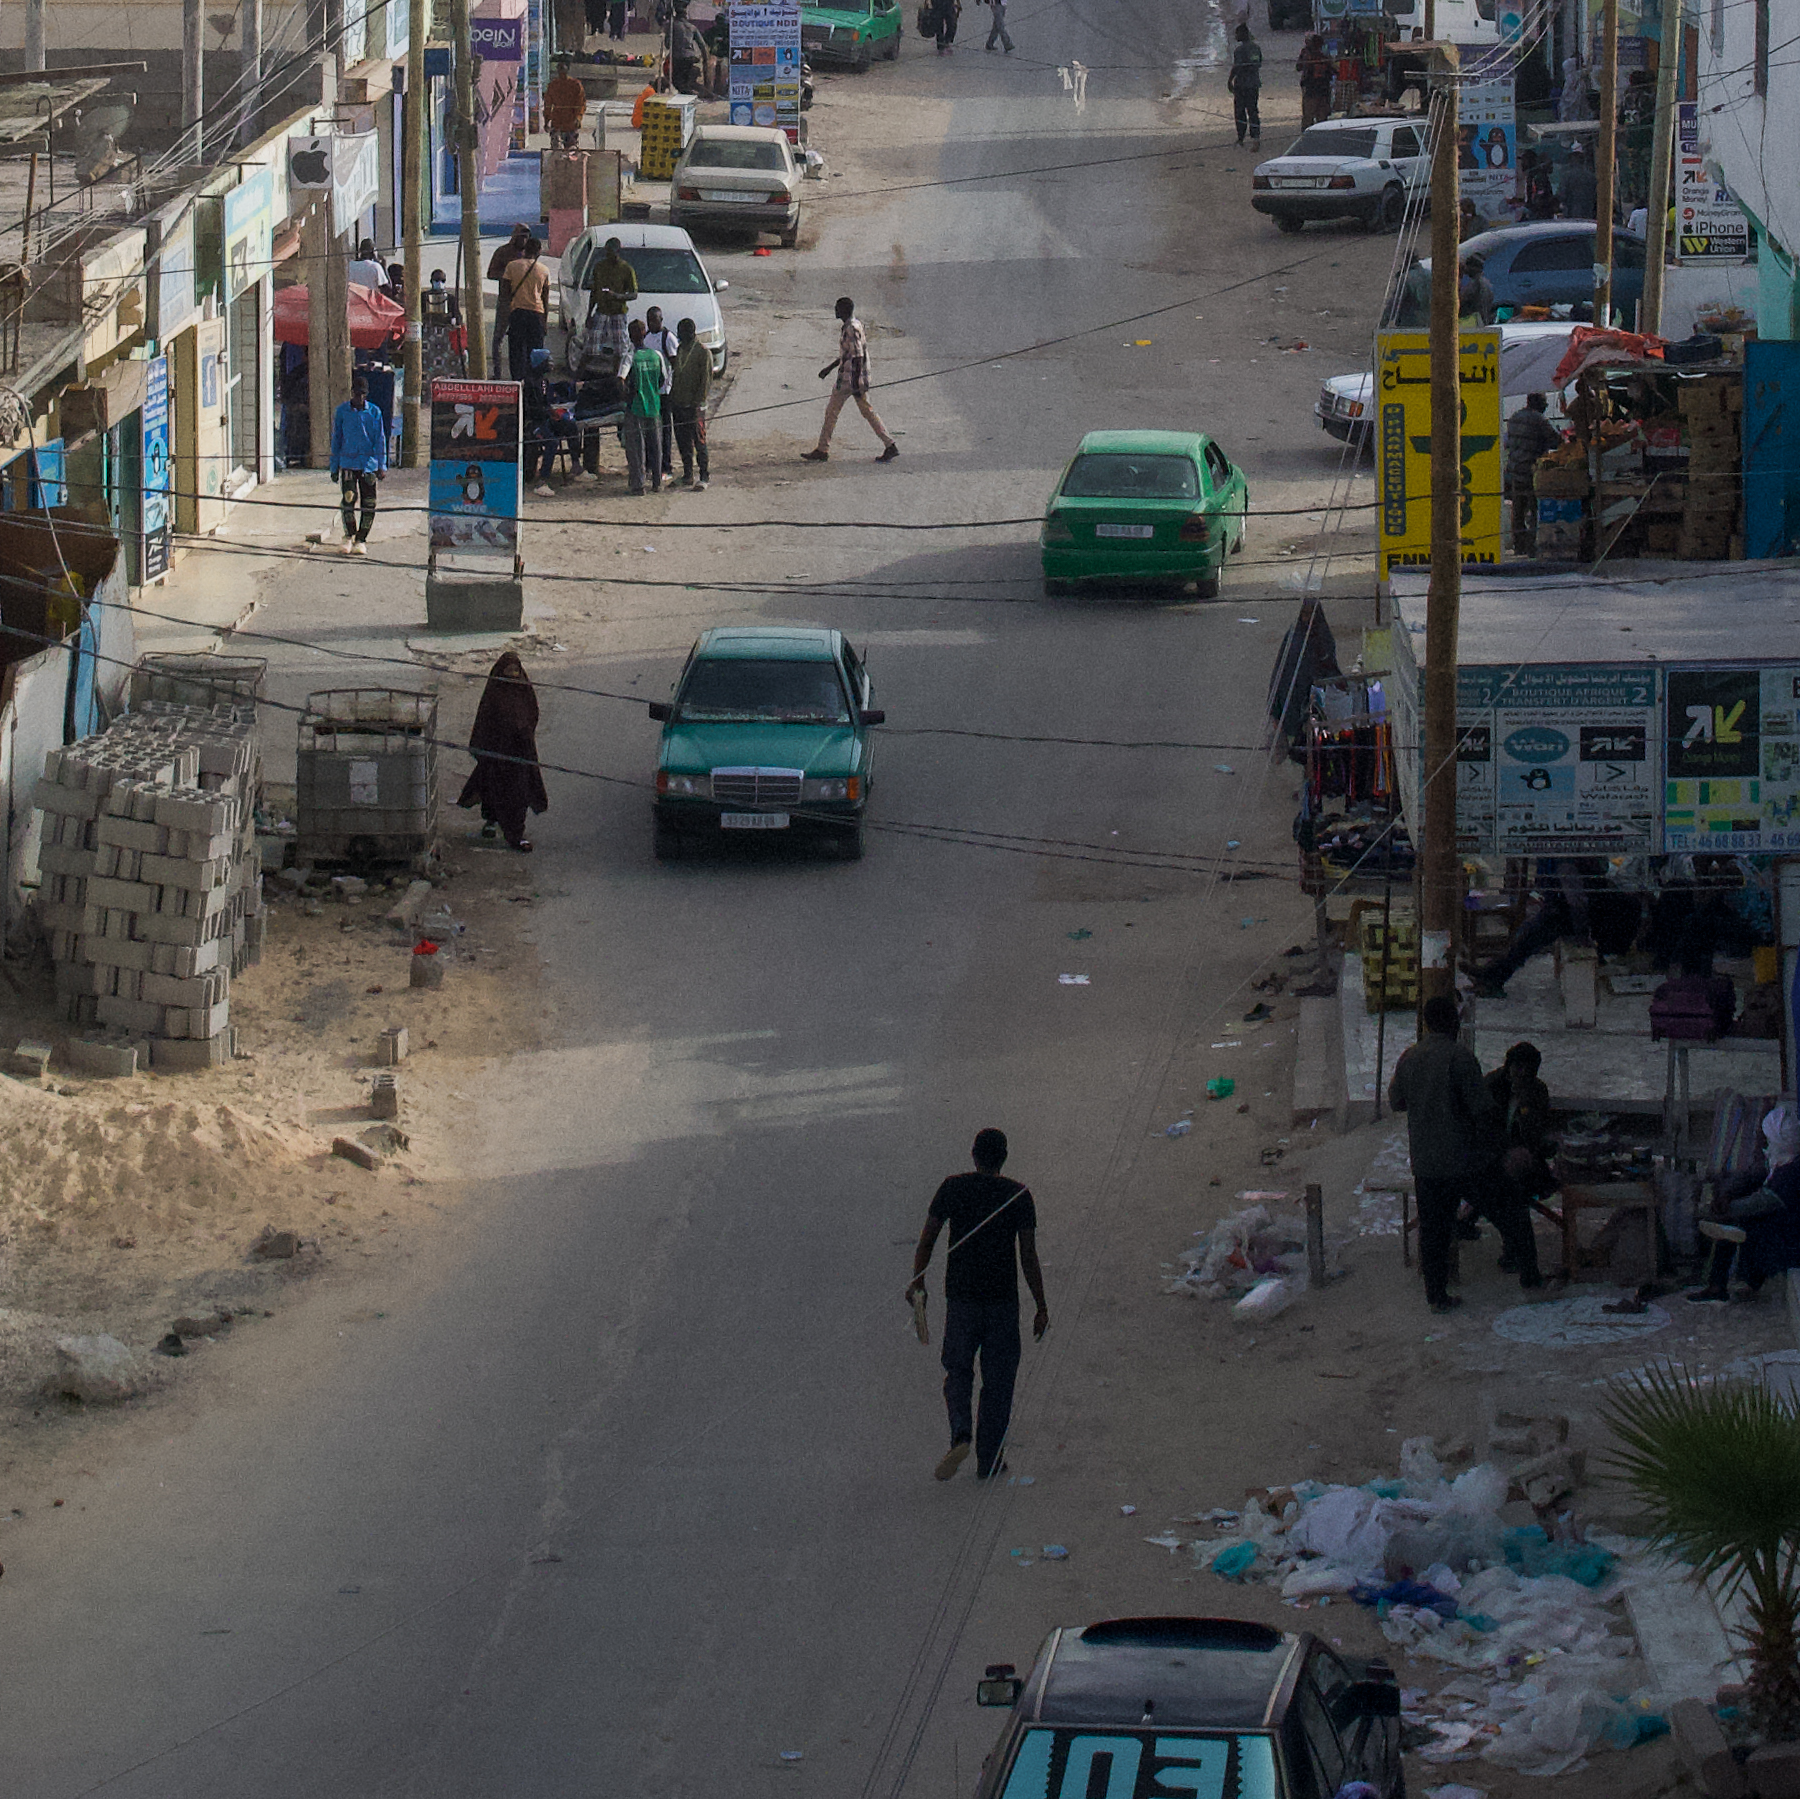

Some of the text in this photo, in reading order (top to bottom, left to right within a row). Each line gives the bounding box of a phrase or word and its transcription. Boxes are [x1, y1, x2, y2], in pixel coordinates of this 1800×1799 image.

[1695, 222, 1744, 234] iPhone
[1709, 236, 1745, 245] Western
[1709, 244, 1736, 253] Union
[1512, 686, 1648, 704] BOUTIQUE AFRIQUE 2
[1502, 697, 1568, 705] TRANSFERT
[1511, 738, 1565, 751] Wari
